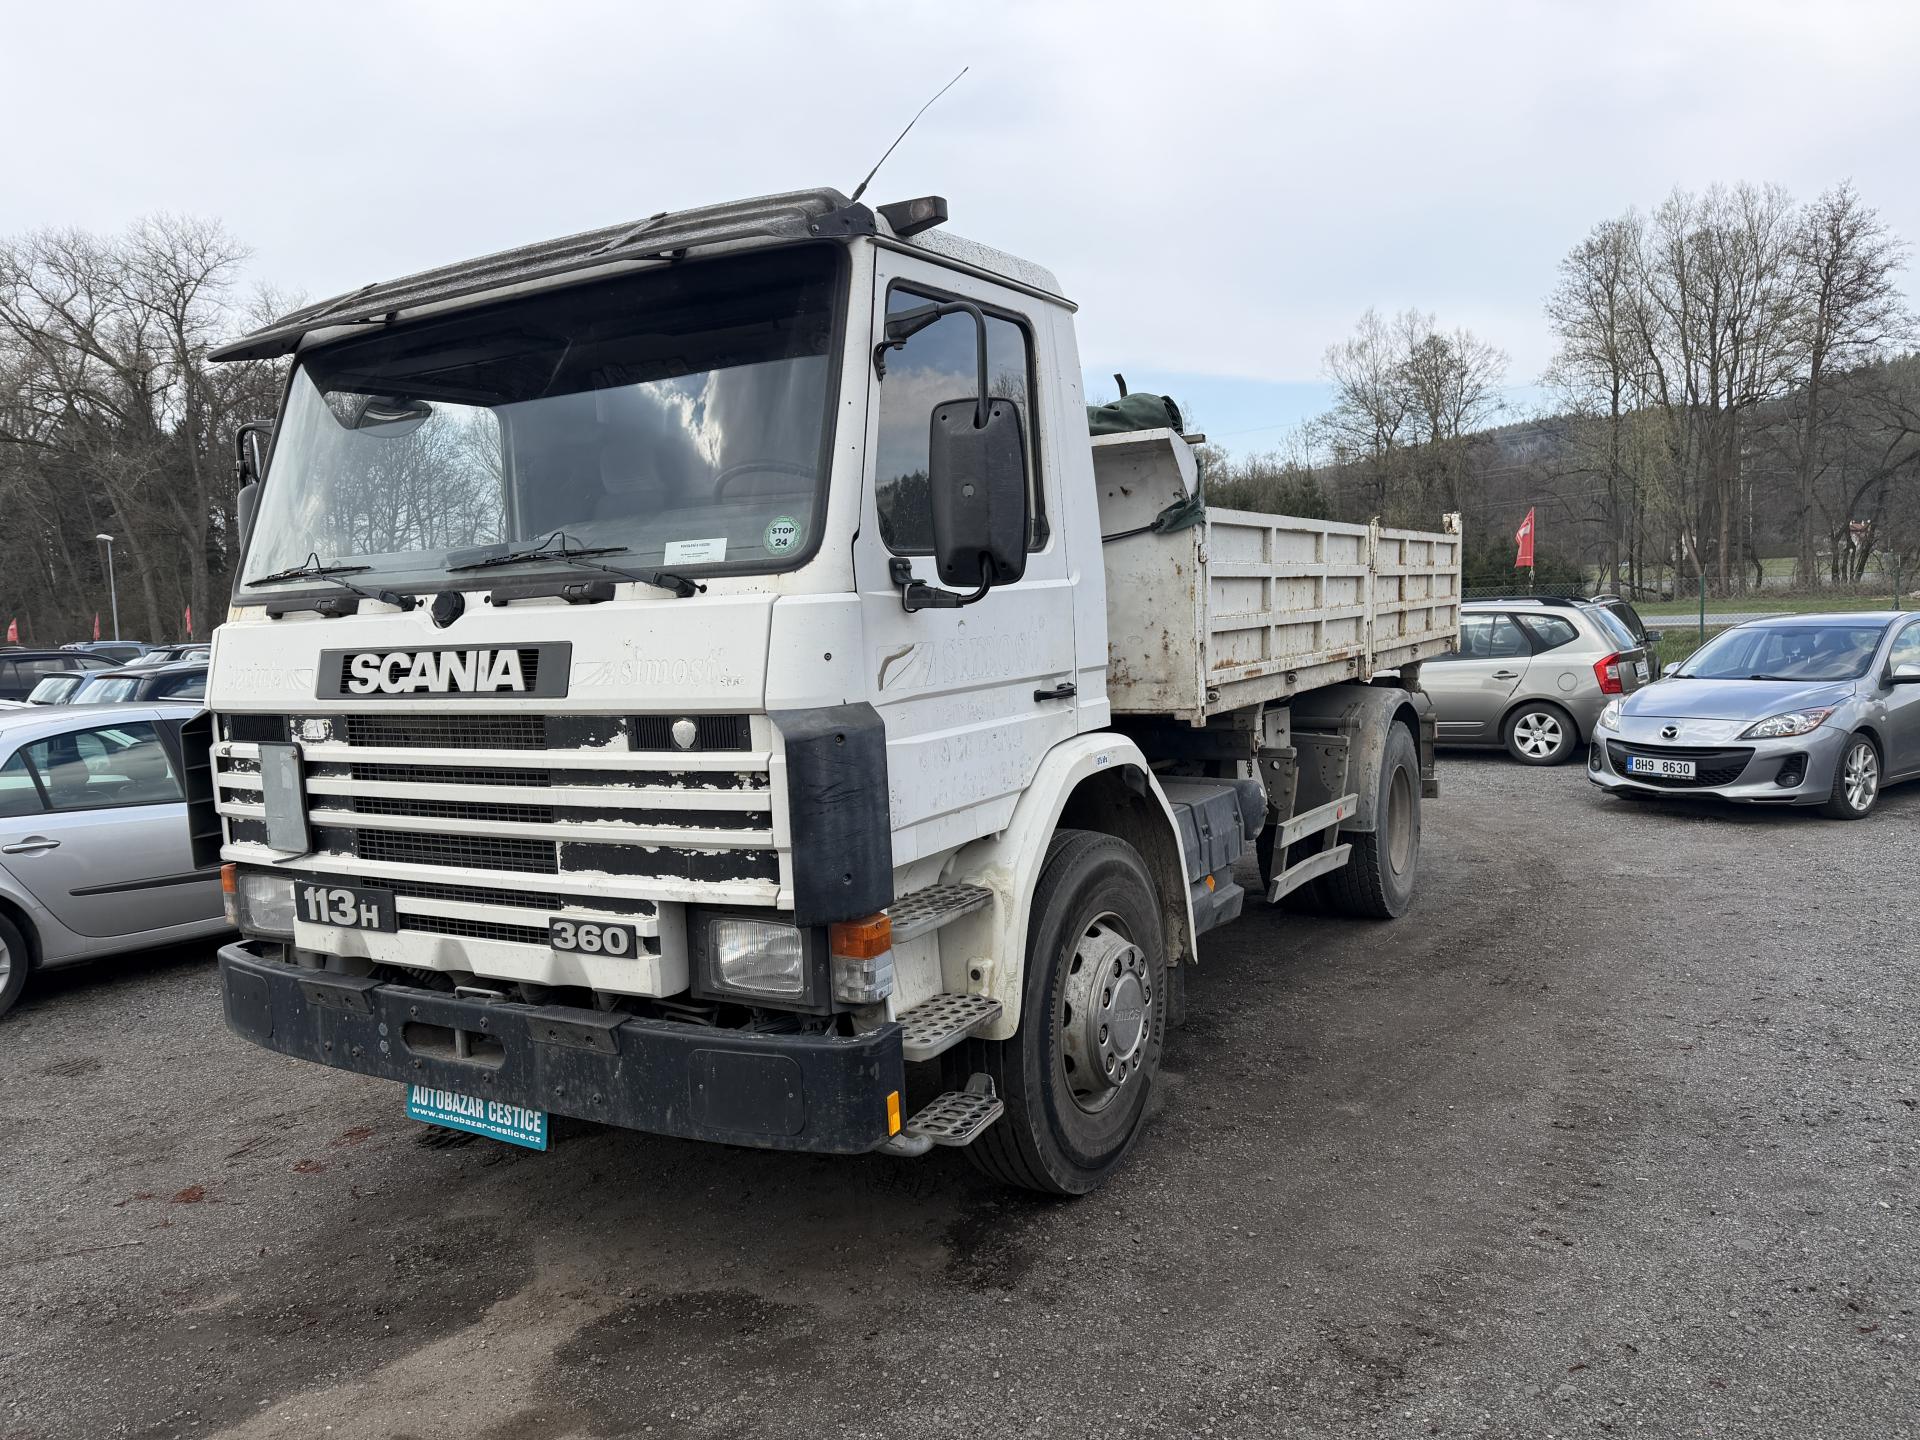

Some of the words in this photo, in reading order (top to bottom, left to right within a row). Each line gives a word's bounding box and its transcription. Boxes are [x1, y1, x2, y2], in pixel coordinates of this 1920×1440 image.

[772, 527, 795, 535] STOP
[775, 538, 788, 547] 24
[348, 649, 526, 694] SCANIA
[1635, 758, 1655, 772] 8H9
[1662, 761, 1691, 775] 8630
[552, 921, 630, 955] 360
[411, 1107, 541, 1143] www.autobazar-cestice.cz
[412, 1085, 485, 1119] AUTOBAZAR
[488, 1100, 542, 1133] CESTICE
